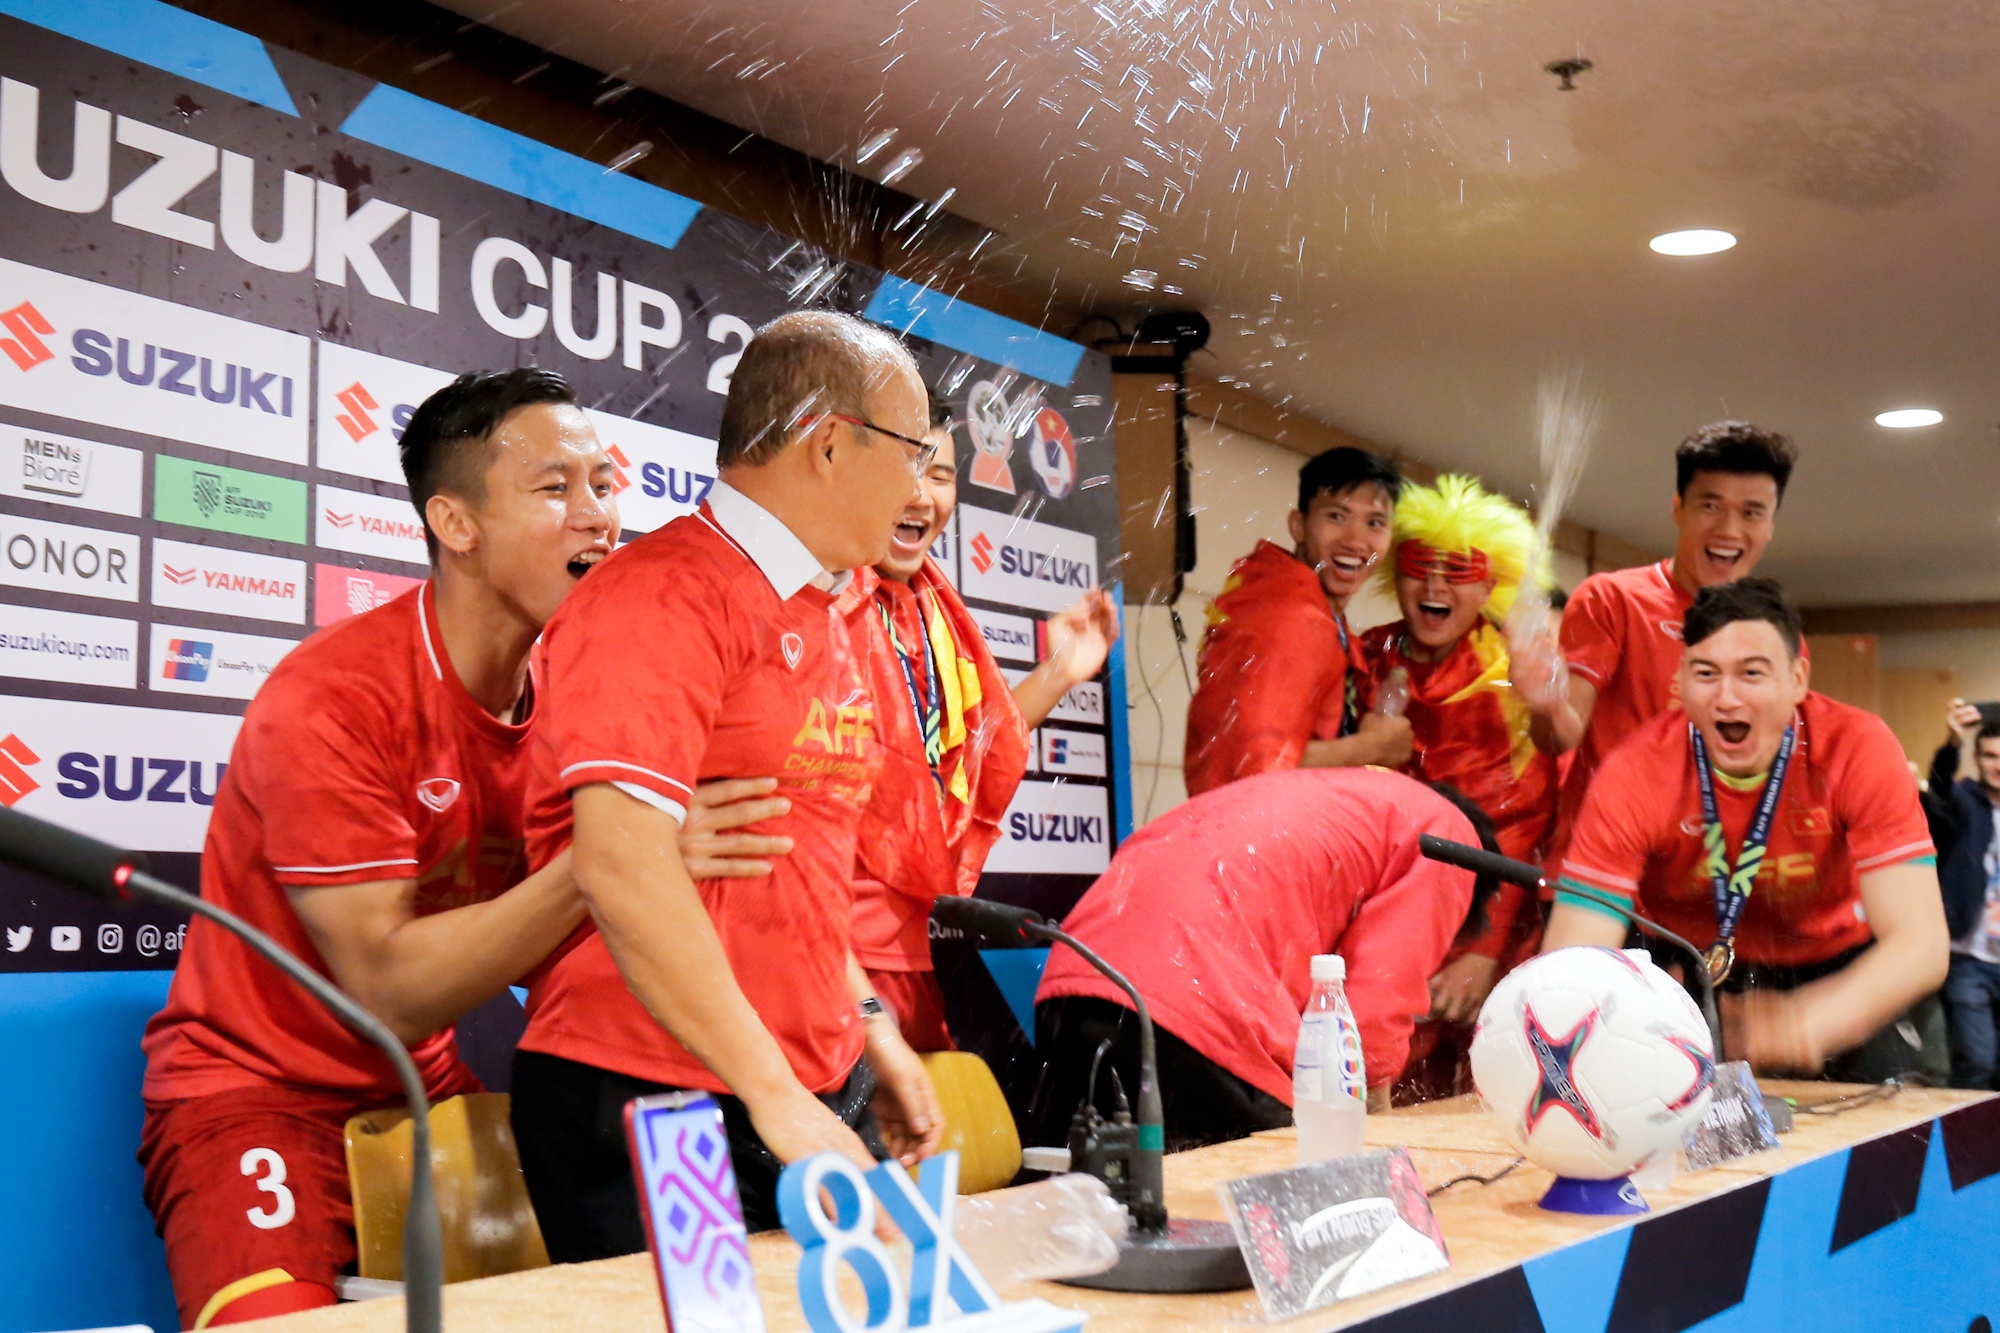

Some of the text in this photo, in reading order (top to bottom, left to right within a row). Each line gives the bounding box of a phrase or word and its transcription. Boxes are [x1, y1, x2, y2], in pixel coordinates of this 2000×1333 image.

[470, 237, 682, 371] CUP
[70, 328, 293, 418] SUZUKI
[225, 495, 272, 512] SUZUKI
[0, 532, 127, 584] ONOR
[1001, 545, 1090, 590] SUZUKI
[204, 570, 295, 600] YANMAR
[983, 626, 1030, 647] SUZUKI
[792, 697, 875, 758] AFF
[1010, 811, 1103, 844] SUZUKI
[239, 1147, 296, 1230] 3
